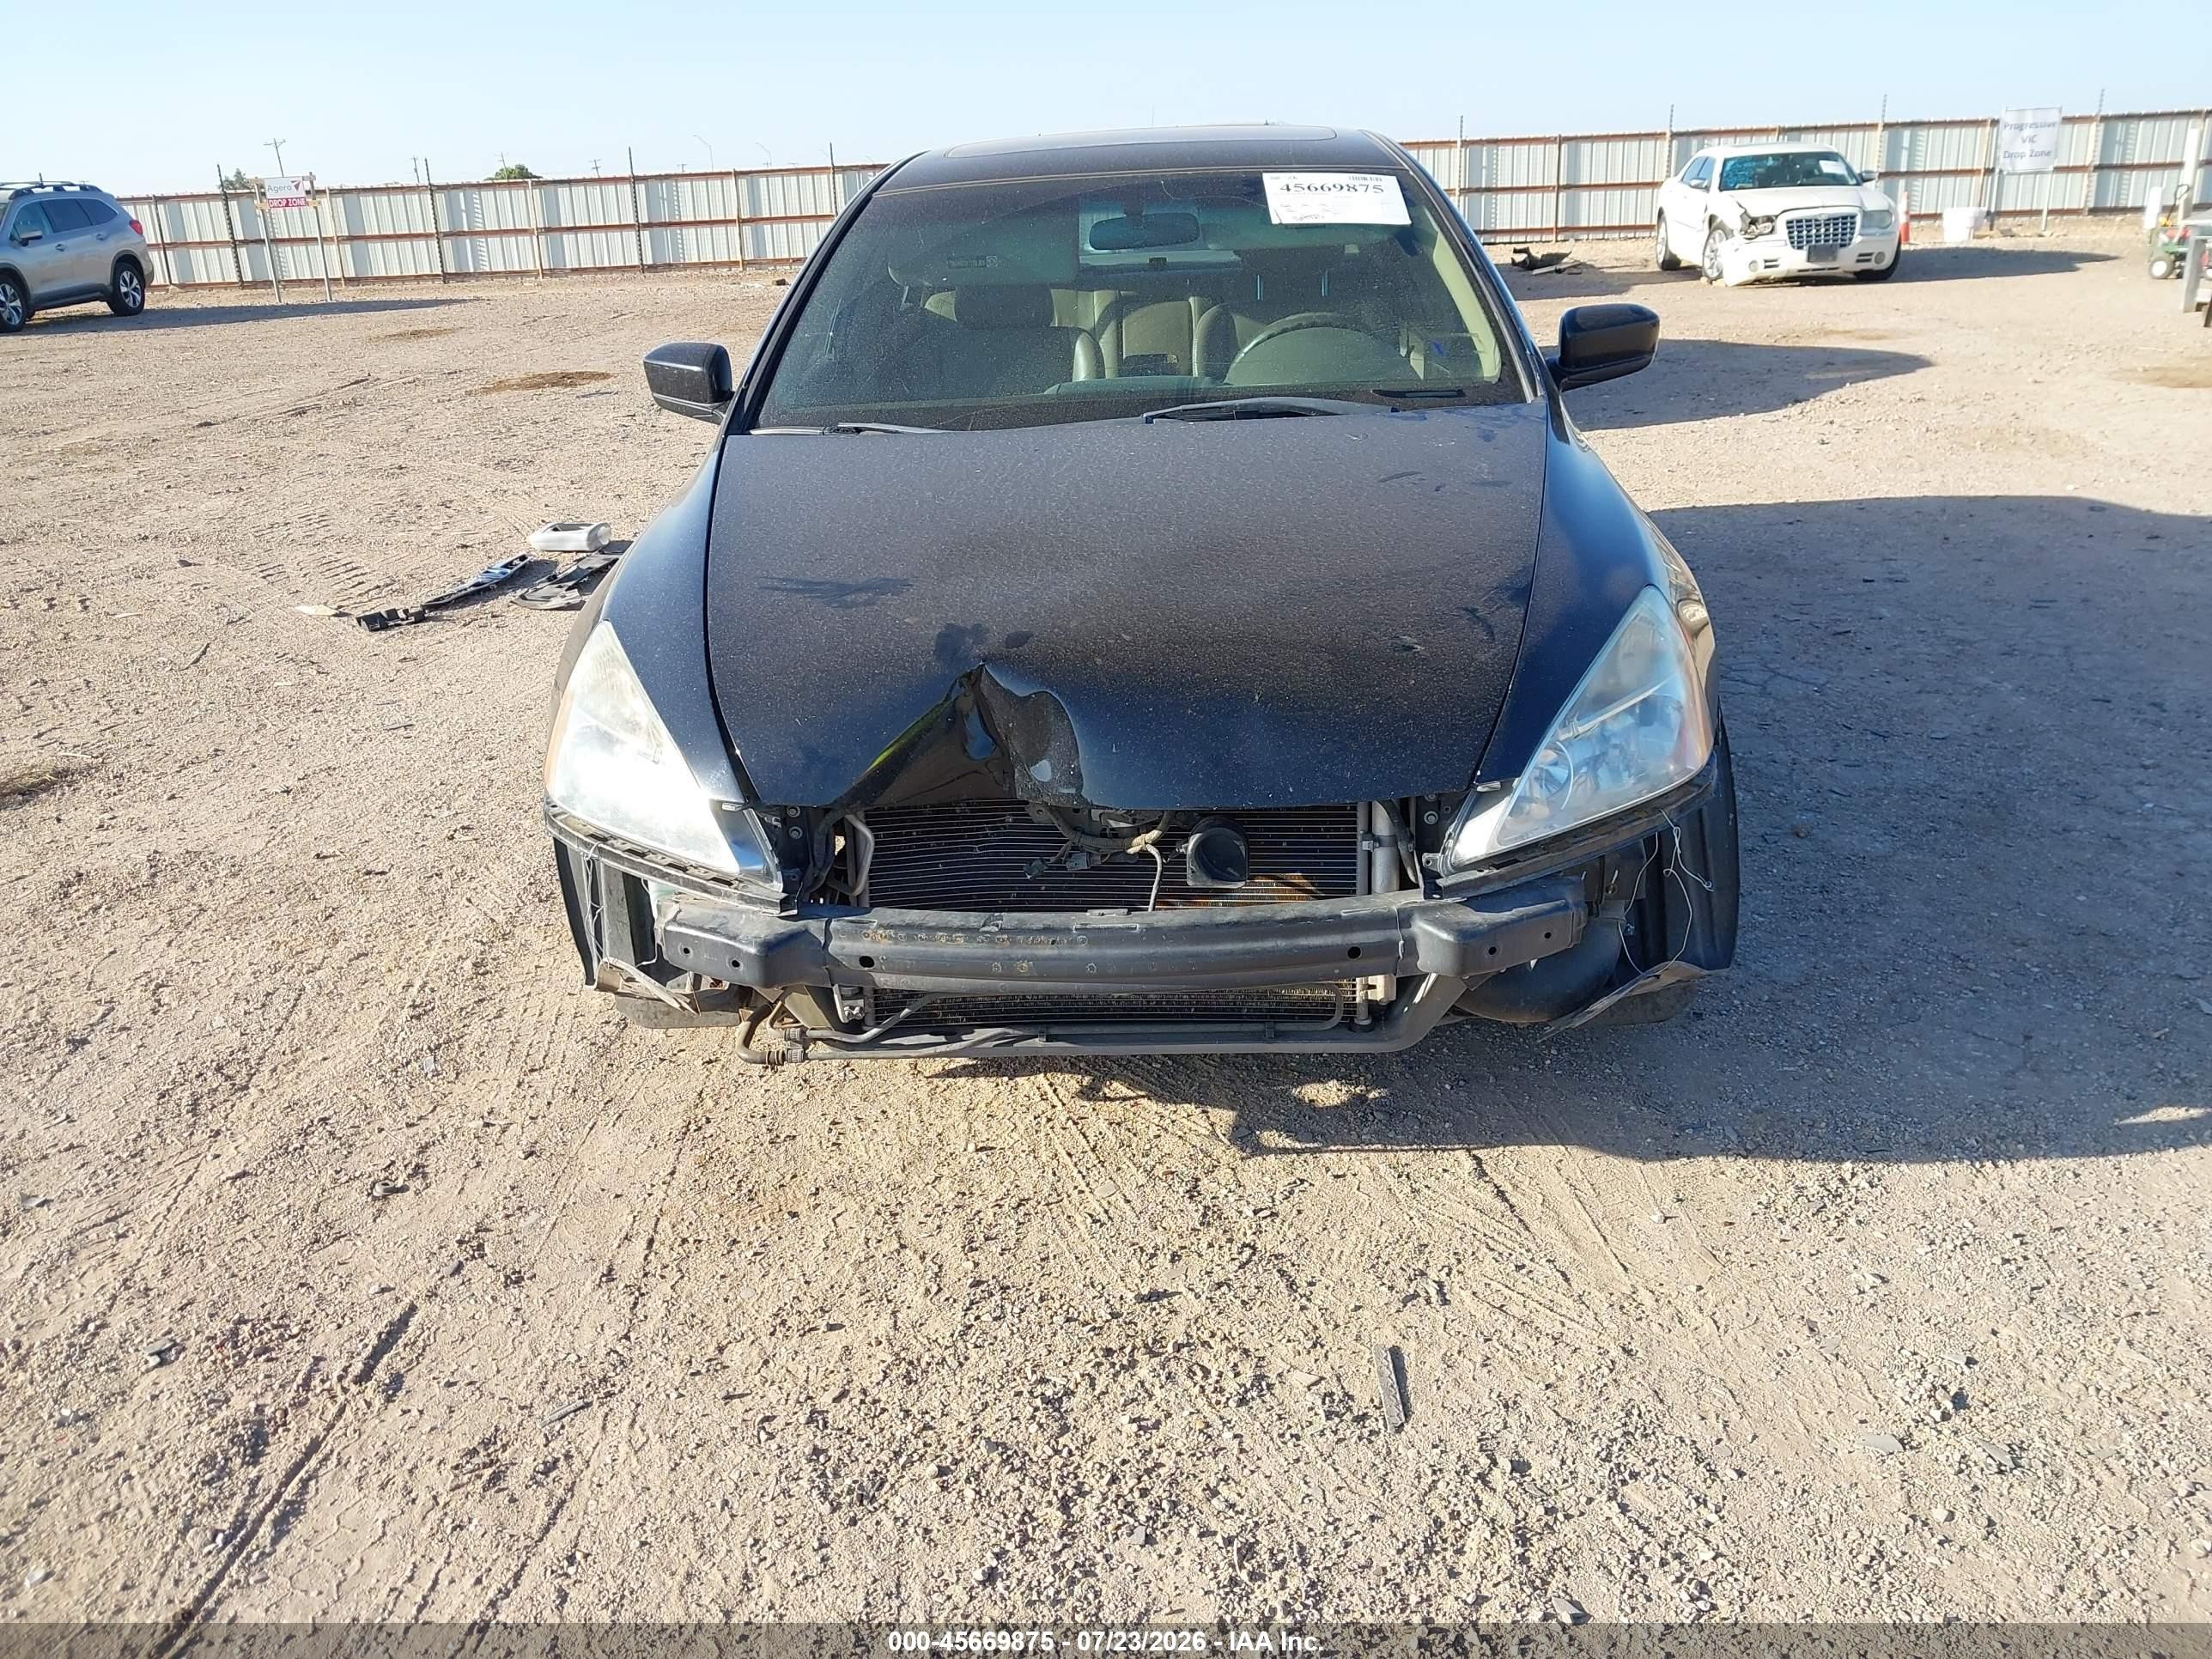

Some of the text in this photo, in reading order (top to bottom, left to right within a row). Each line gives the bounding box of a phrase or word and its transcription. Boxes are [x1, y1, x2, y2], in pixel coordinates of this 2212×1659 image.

[2002, 122, 2057, 131] Progressive
[2003, 149, 2052, 161] Drop Zone
[267, 185, 292, 193] Agero
[1279, 183, 1384, 193] 45669875
